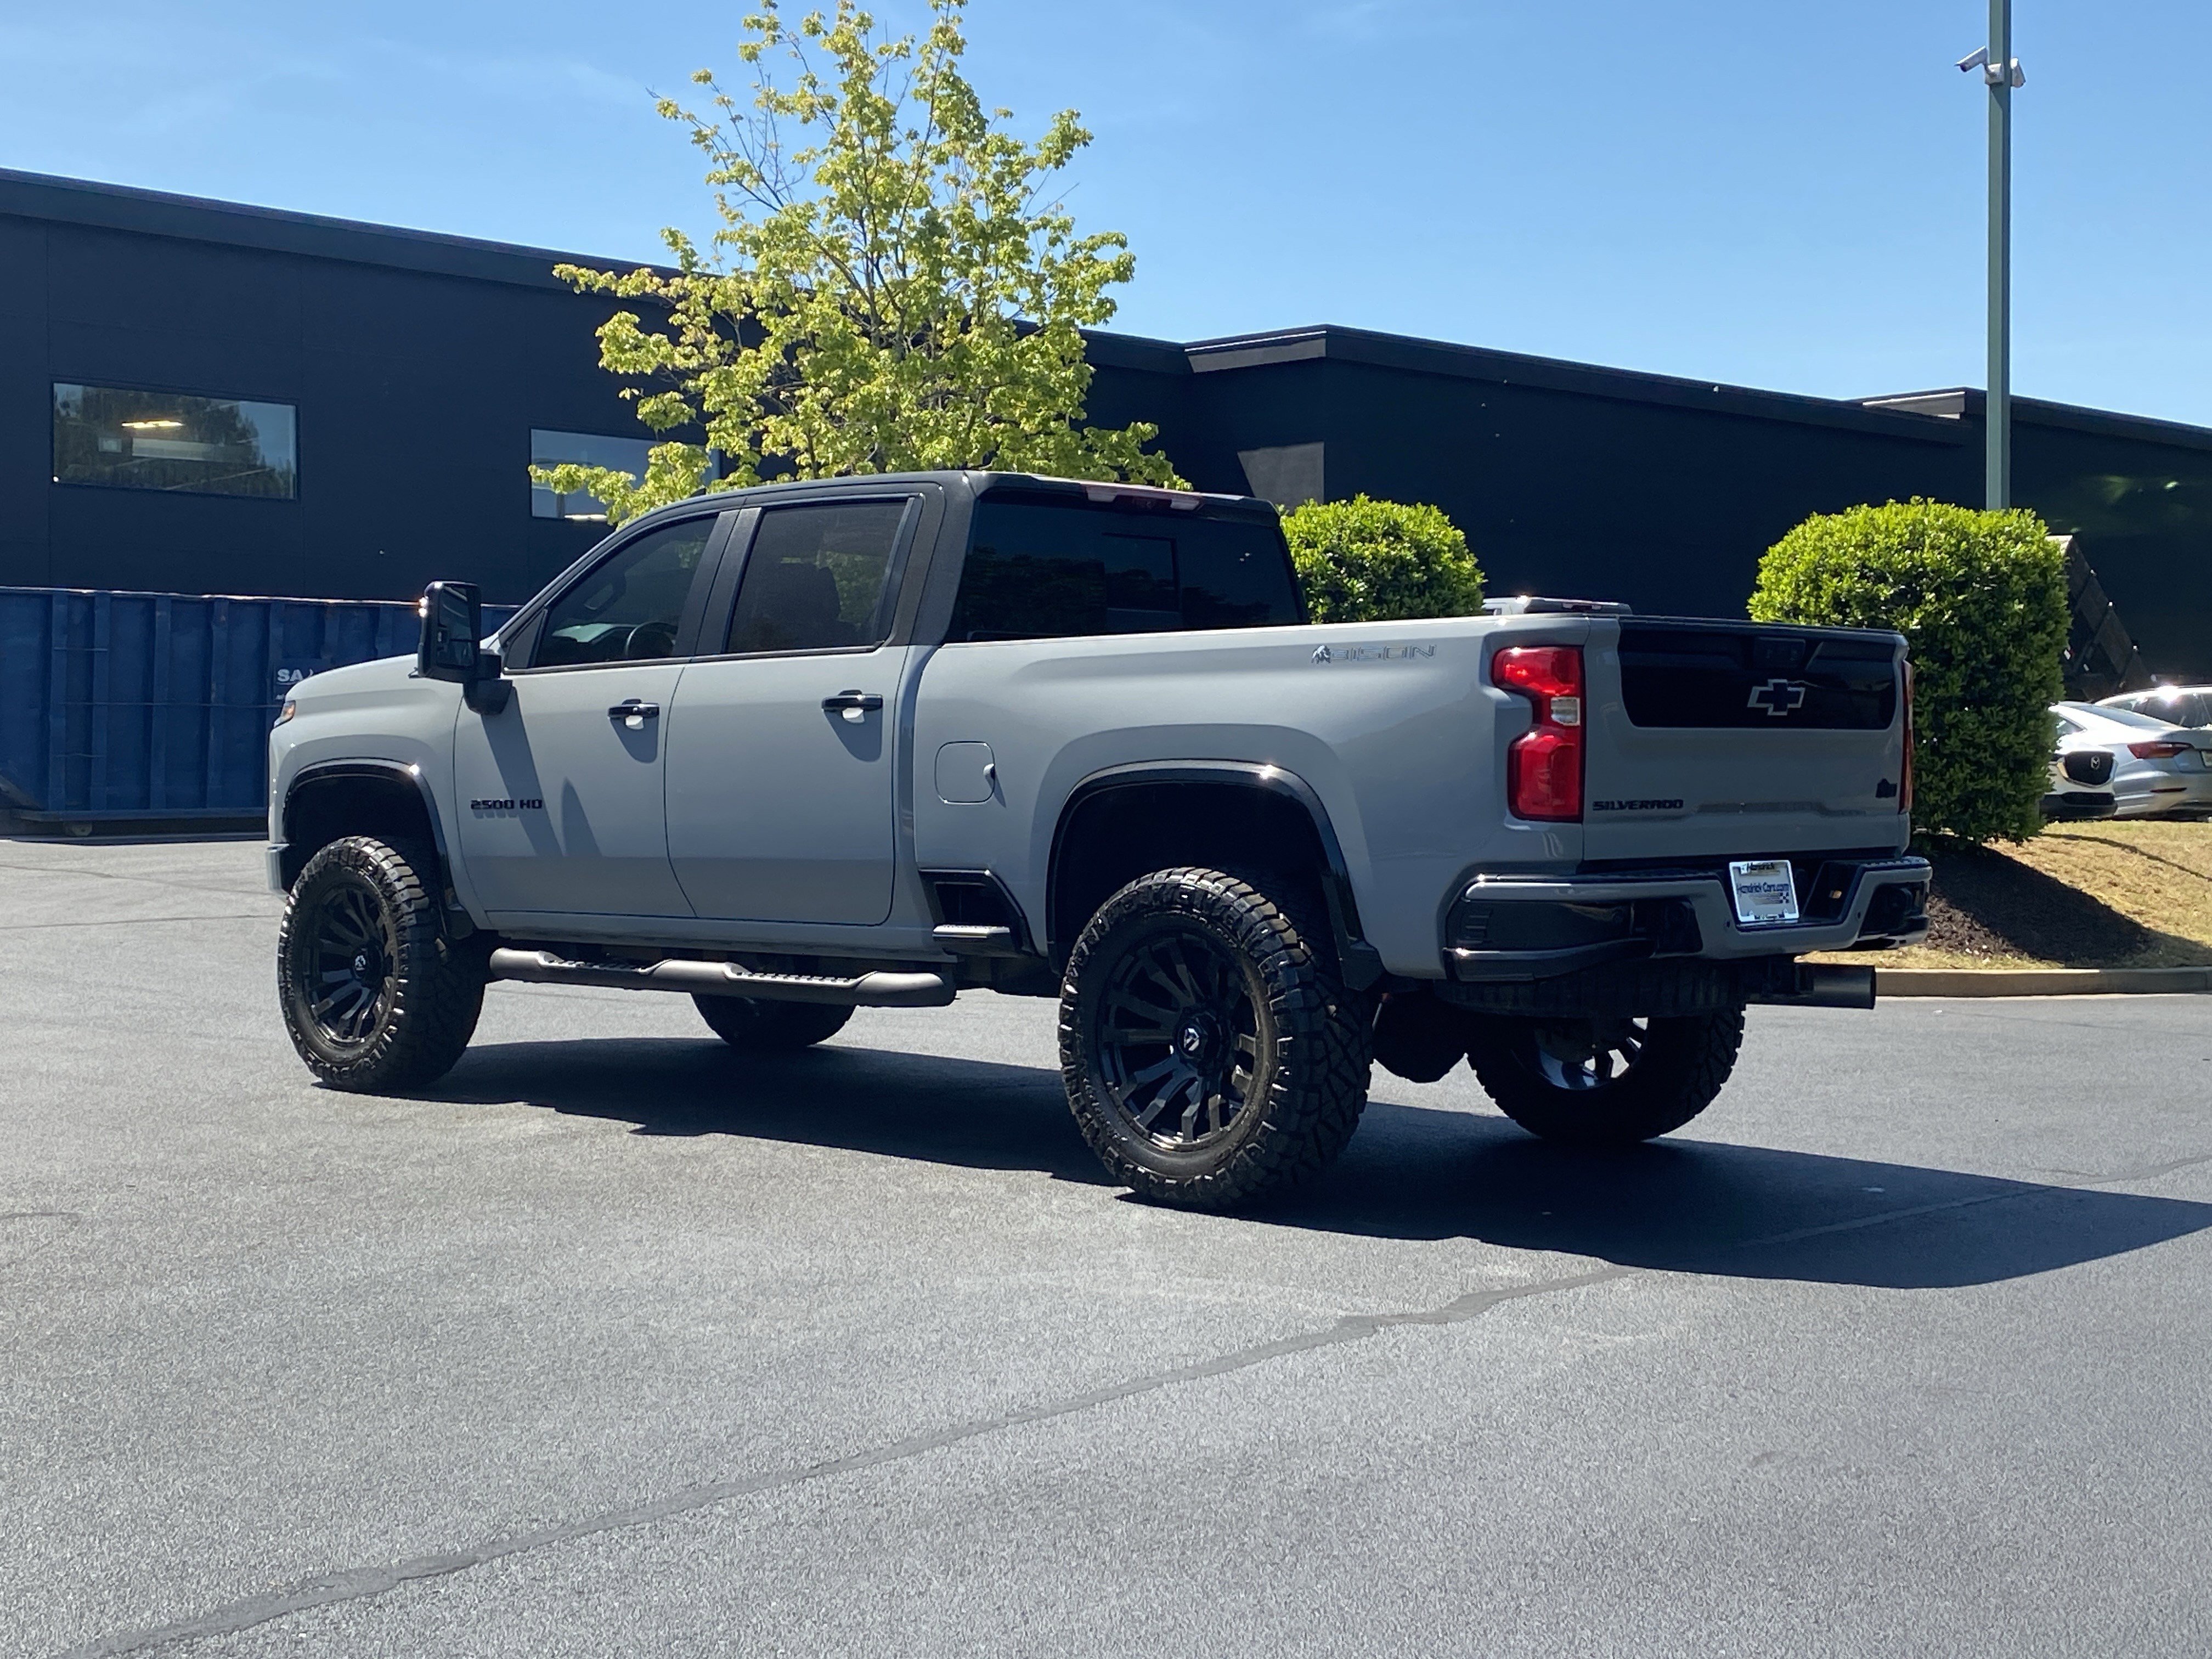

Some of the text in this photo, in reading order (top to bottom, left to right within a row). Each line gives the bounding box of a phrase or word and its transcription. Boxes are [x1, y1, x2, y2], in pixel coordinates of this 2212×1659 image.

[1331, 645, 1436, 661] BISON
[471, 799, 543, 809] 2500 HD
[1593, 799, 1684, 810] SILVERADO
